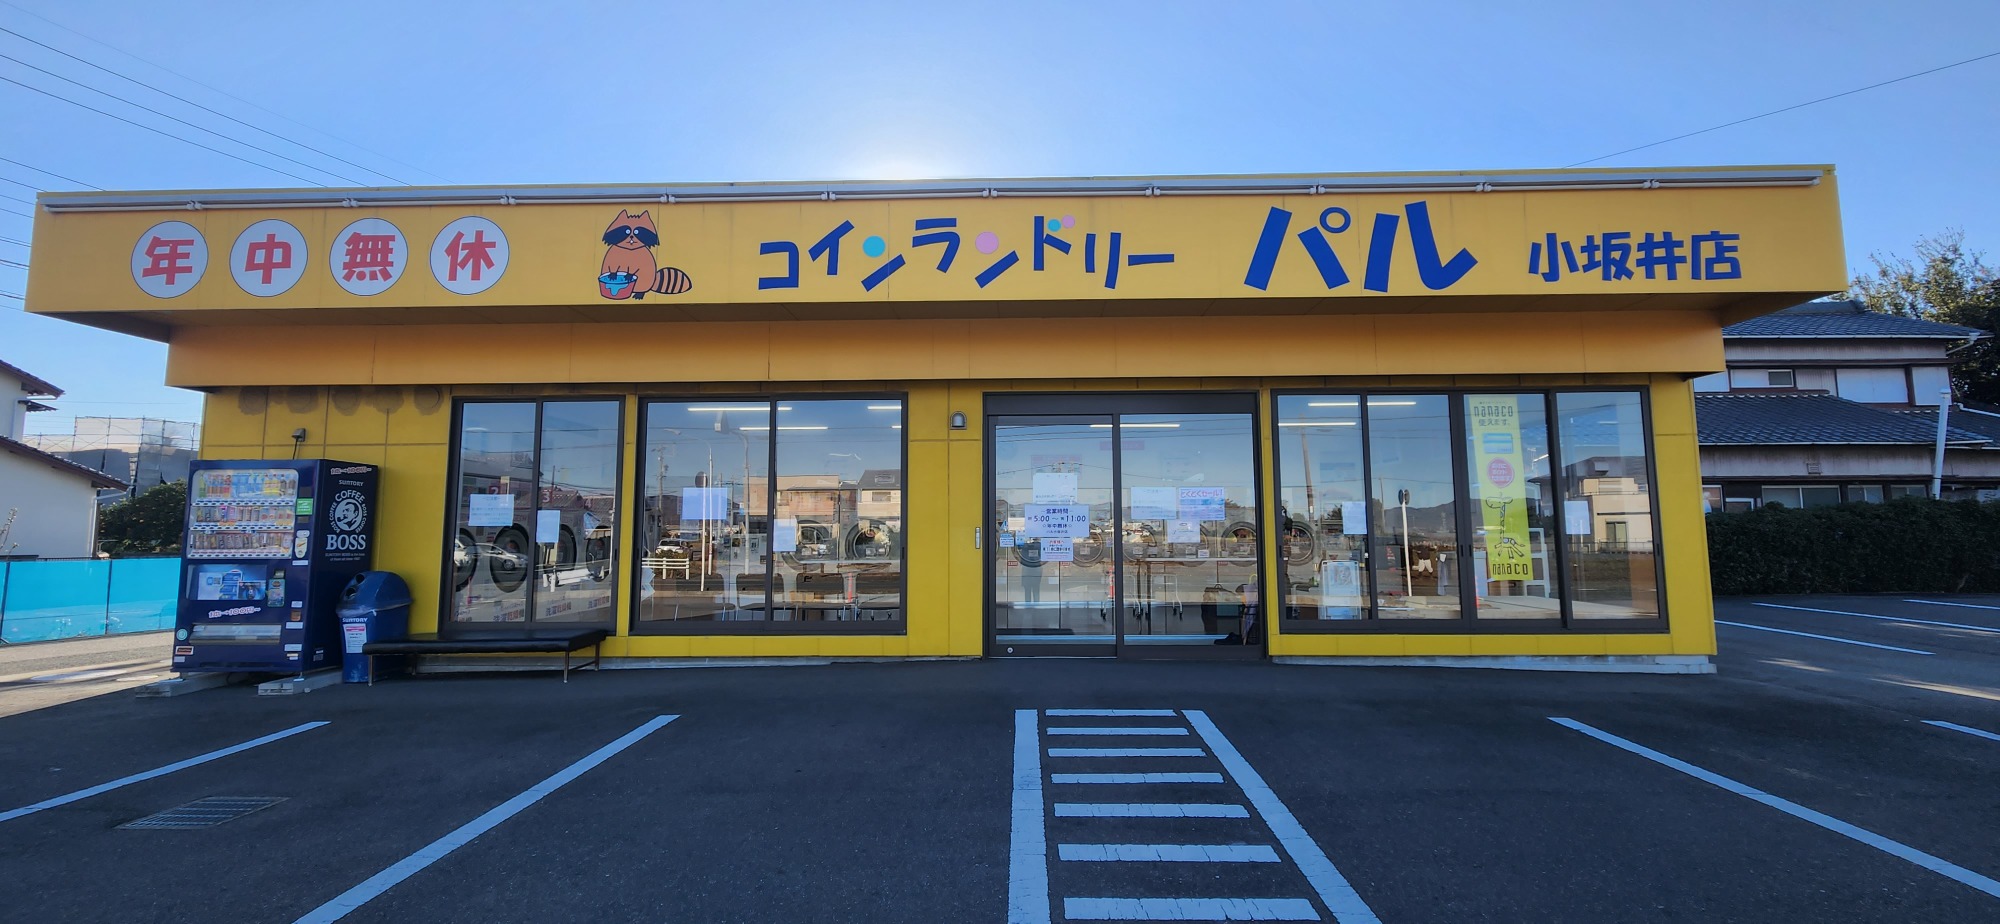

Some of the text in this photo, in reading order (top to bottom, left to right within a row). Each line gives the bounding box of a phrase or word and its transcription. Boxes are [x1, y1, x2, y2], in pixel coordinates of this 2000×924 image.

[758, 201, 1741, 292] コインランドリー パル 小坂井店
[145, 233, 494, 283] 年中無休
[1473, 405, 1513, 417] nanaco
[335, 489, 365, 503] COFFEE
[542, 491, 550, 503] 3
[325, 534, 366, 550] BOSS
[1493, 563, 1528, 575] nanaco
